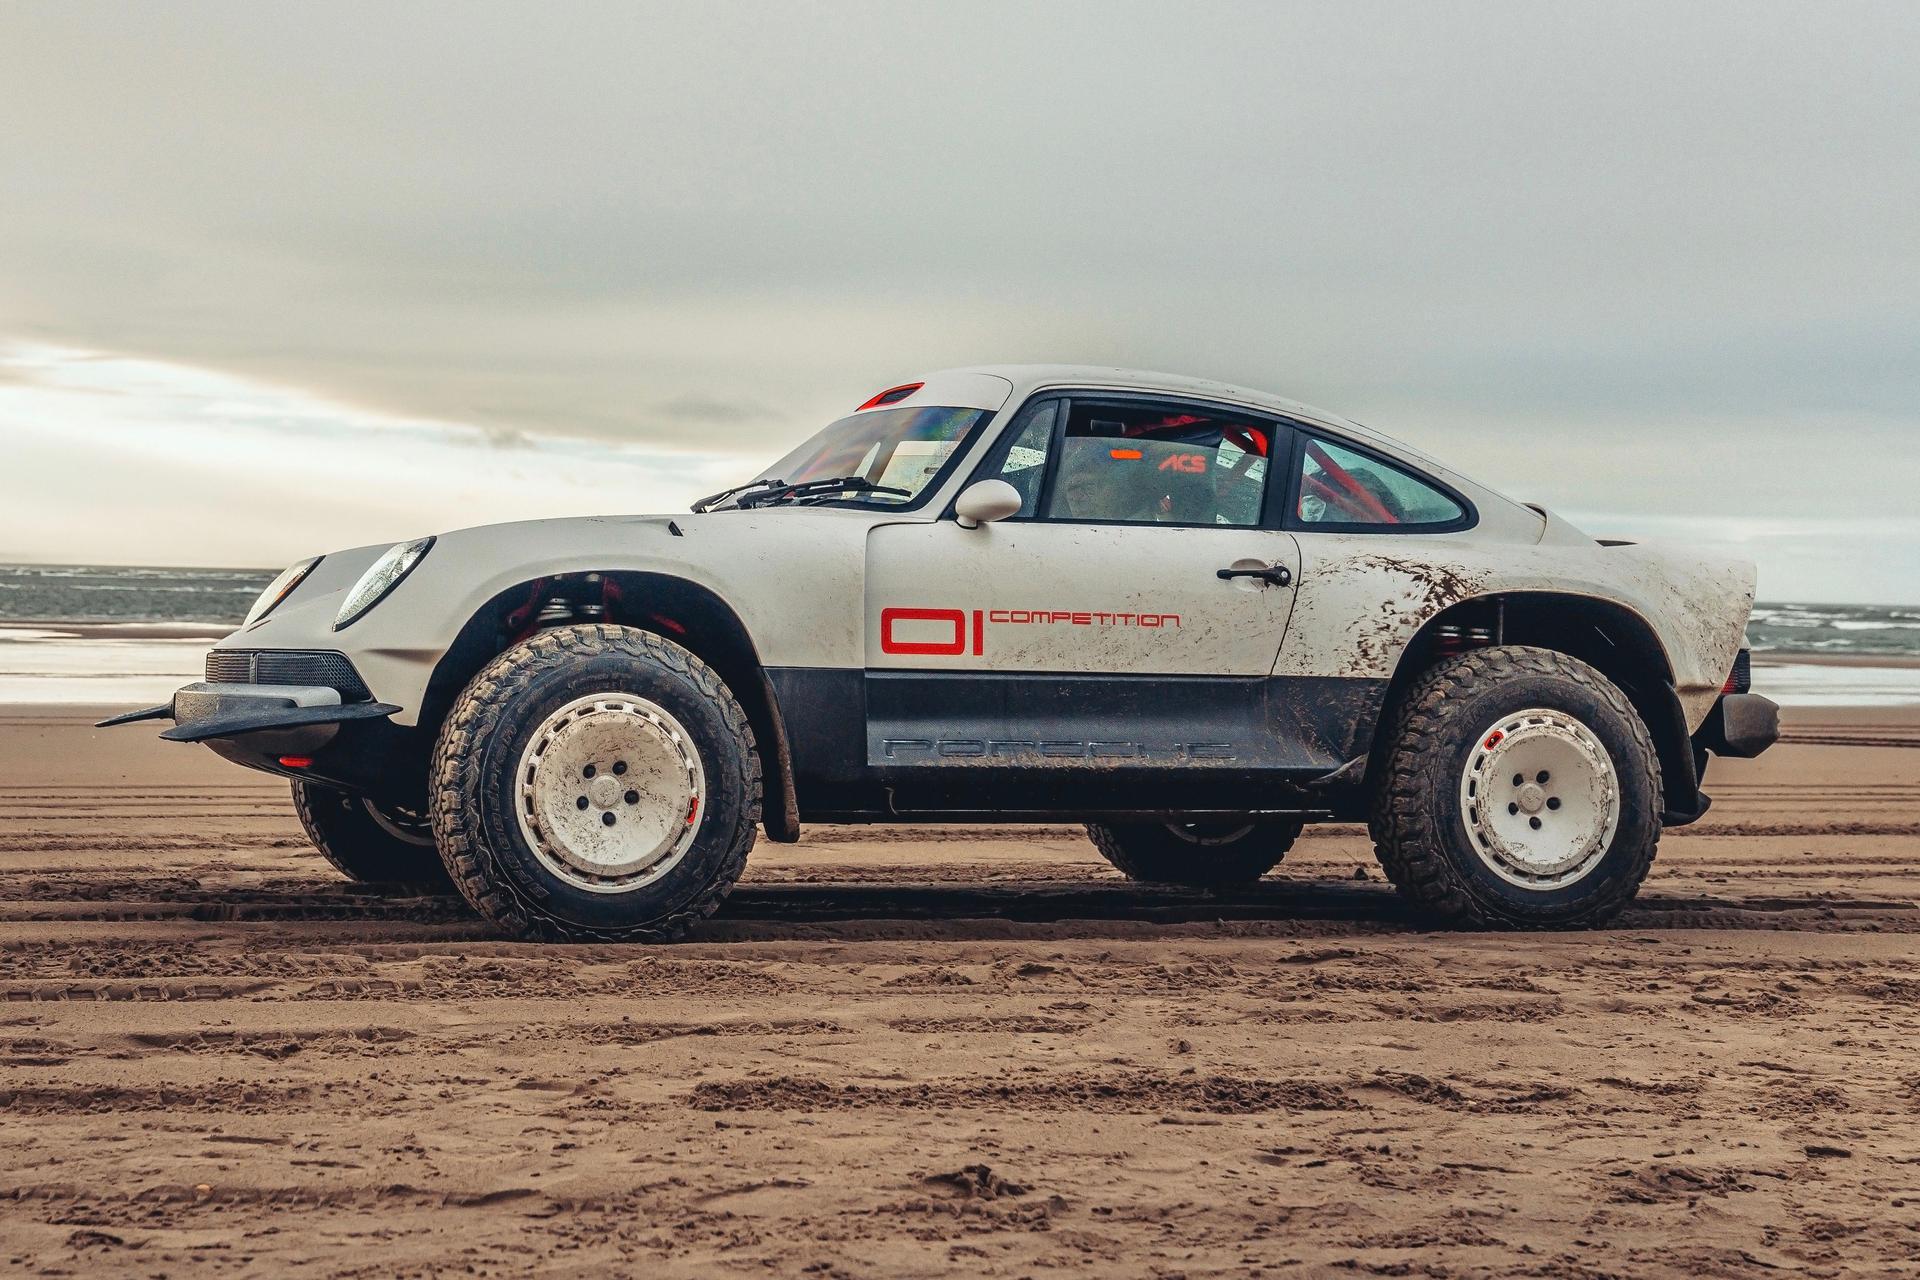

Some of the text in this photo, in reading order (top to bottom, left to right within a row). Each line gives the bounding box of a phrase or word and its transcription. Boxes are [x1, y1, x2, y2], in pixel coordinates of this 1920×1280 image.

[1158, 453, 1206, 473] ACS
[881, 607, 1180, 655] 01 COMPETITION
